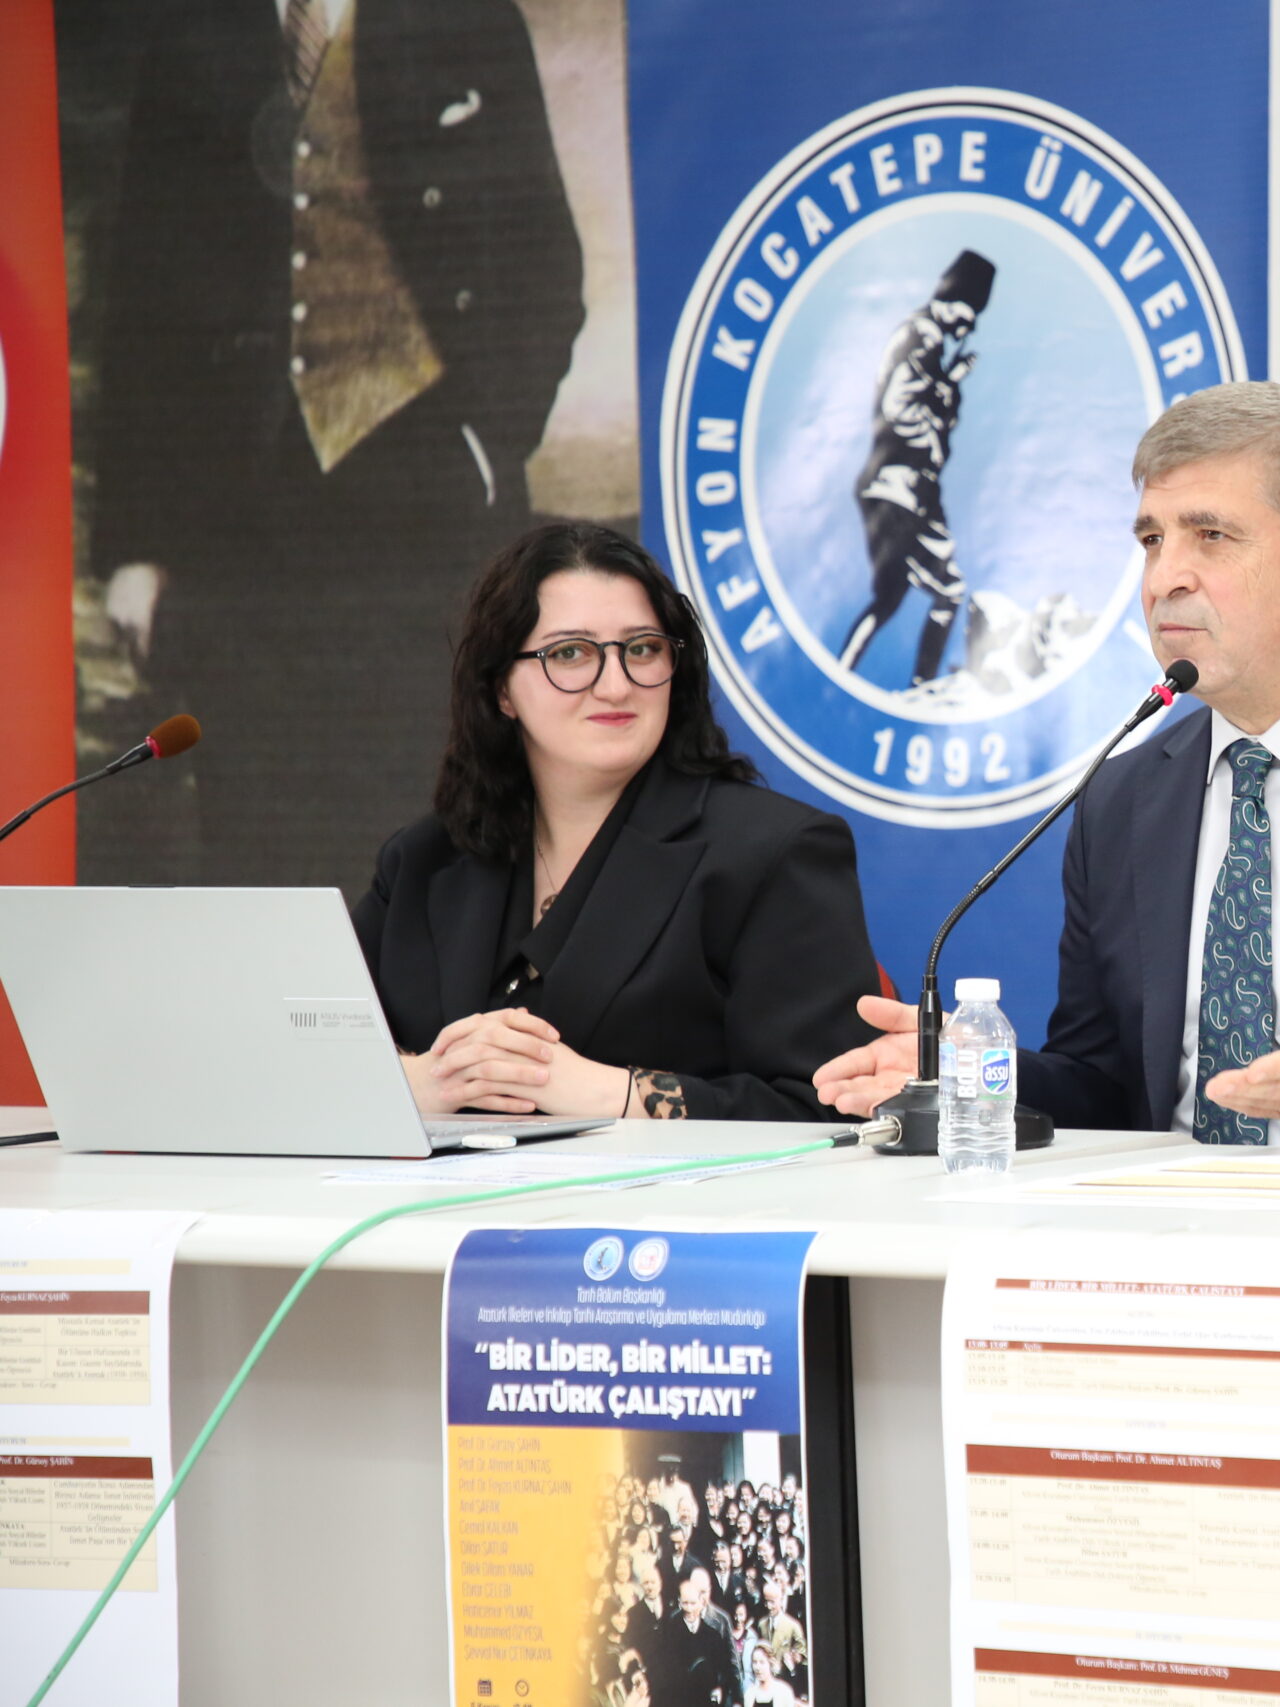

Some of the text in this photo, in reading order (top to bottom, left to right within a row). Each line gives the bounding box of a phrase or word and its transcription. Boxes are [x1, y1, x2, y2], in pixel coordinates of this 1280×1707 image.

[712, 130, 988, 371] KOCATEPE
[696, 416, 783, 655] AFYON
[873, 727, 1011, 788] 1992
[577, 1287, 596, 1303] Tarih
[534, 1312, 544, 1323] ve
[635, 1311, 645, 1324] ve
[536, 1337, 618, 1377] LİDER,
[622, 1339, 667, 1373] BİR
[670, 1340, 772, 1376] MİLLET:
[487, 1379, 605, 1414] ATATÜRK
